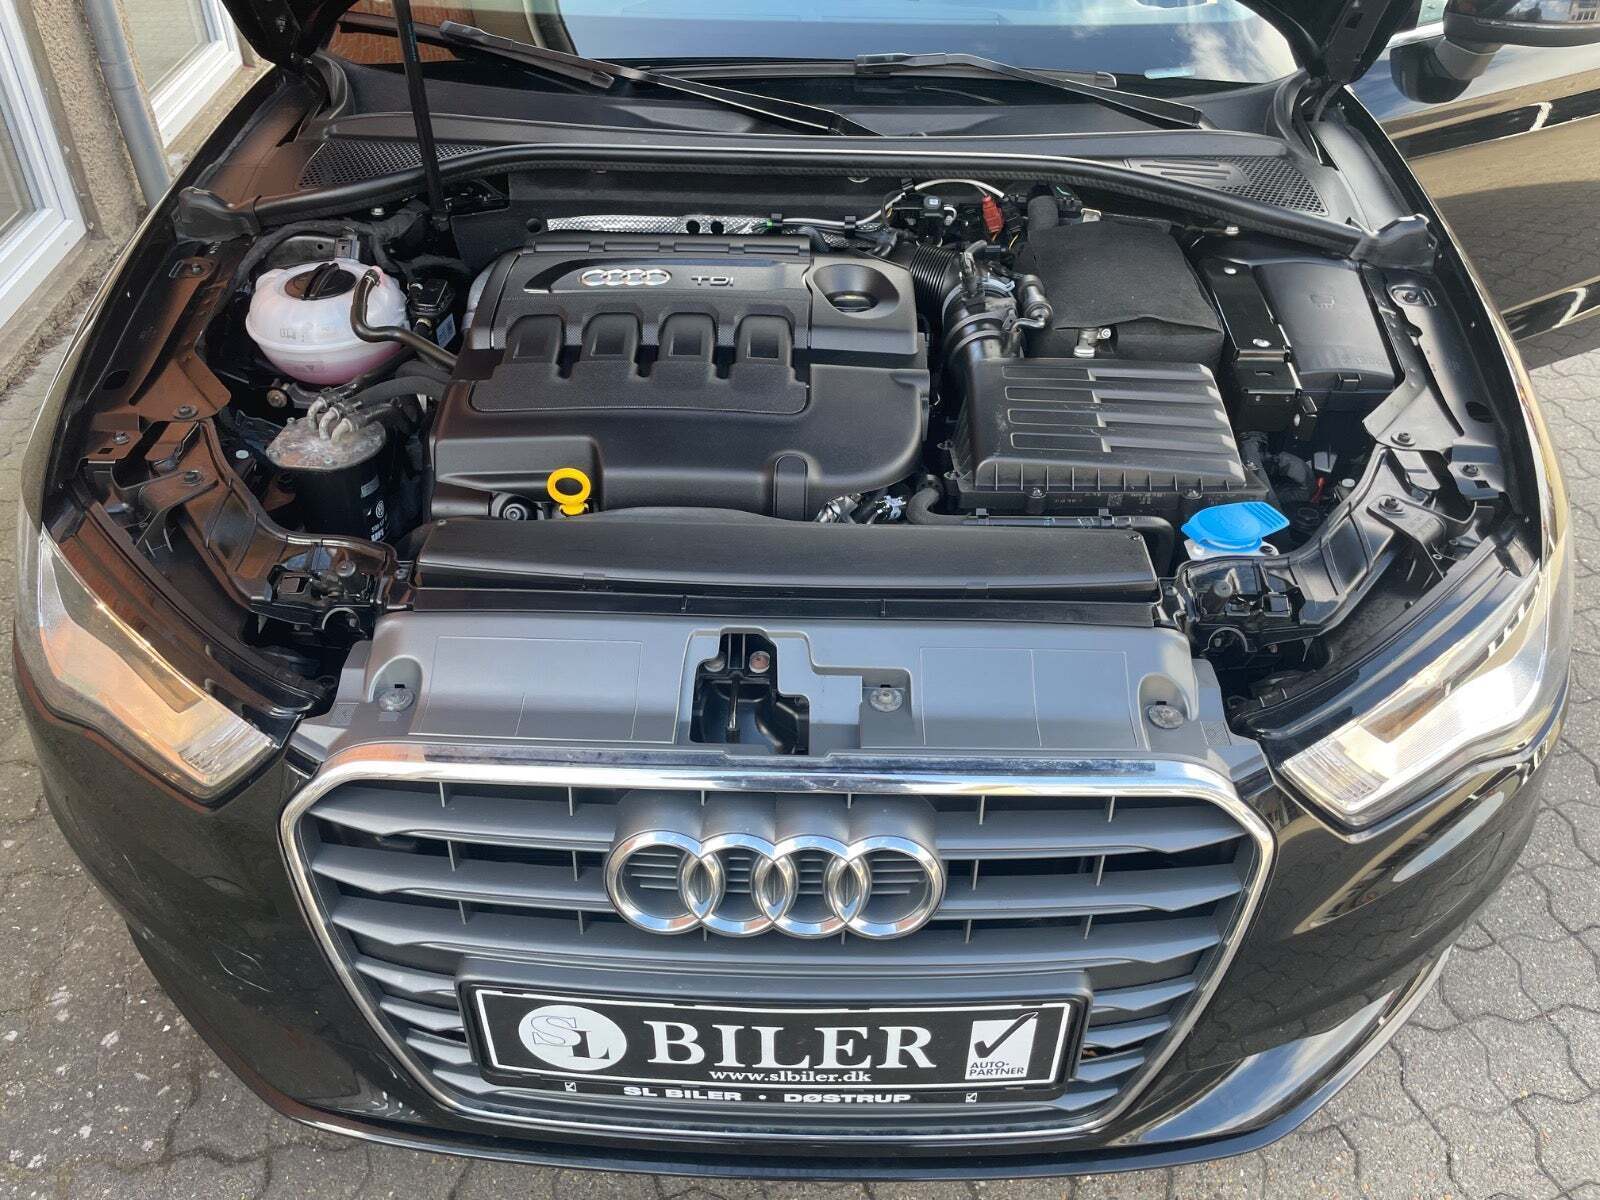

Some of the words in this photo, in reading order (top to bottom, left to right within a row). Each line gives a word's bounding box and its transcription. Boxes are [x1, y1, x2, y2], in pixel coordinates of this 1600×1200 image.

[691, 275, 734, 287] TDI
[643, 1020, 937, 1070] BILER
[969, 1060, 1010, 1069] AUTO-
[709, 1070, 872, 1083] www.slbiler.dk
[969, 1066, 1025, 1077] PARTNER
[623, 1086, 658, 1097] SL
[664, 1088, 742, 1101] BILER
[783, 1093, 911, 1103] DØSTRUP
